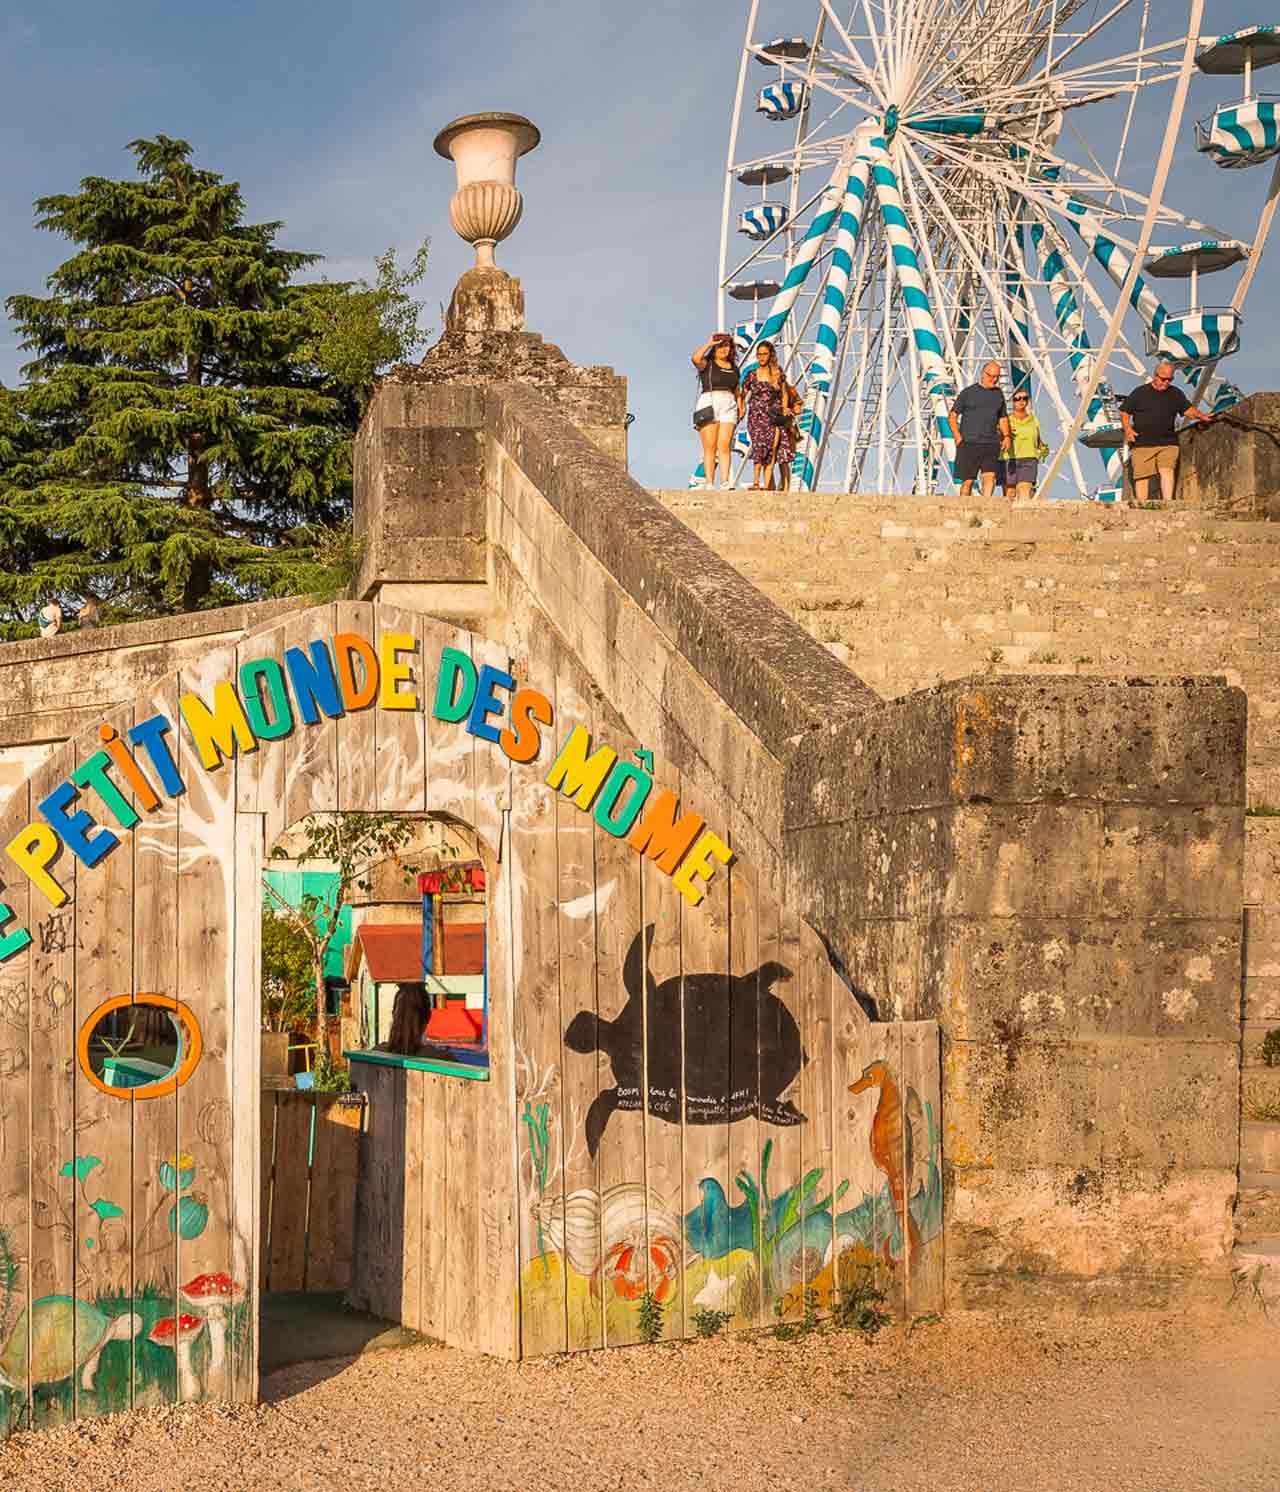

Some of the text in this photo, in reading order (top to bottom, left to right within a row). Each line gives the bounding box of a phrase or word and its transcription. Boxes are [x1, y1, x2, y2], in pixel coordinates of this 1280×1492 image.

[180, 632, 419, 771] MONDE
[432, 647, 554, 764] DES
[545, 725, 735, 907] MÔME
